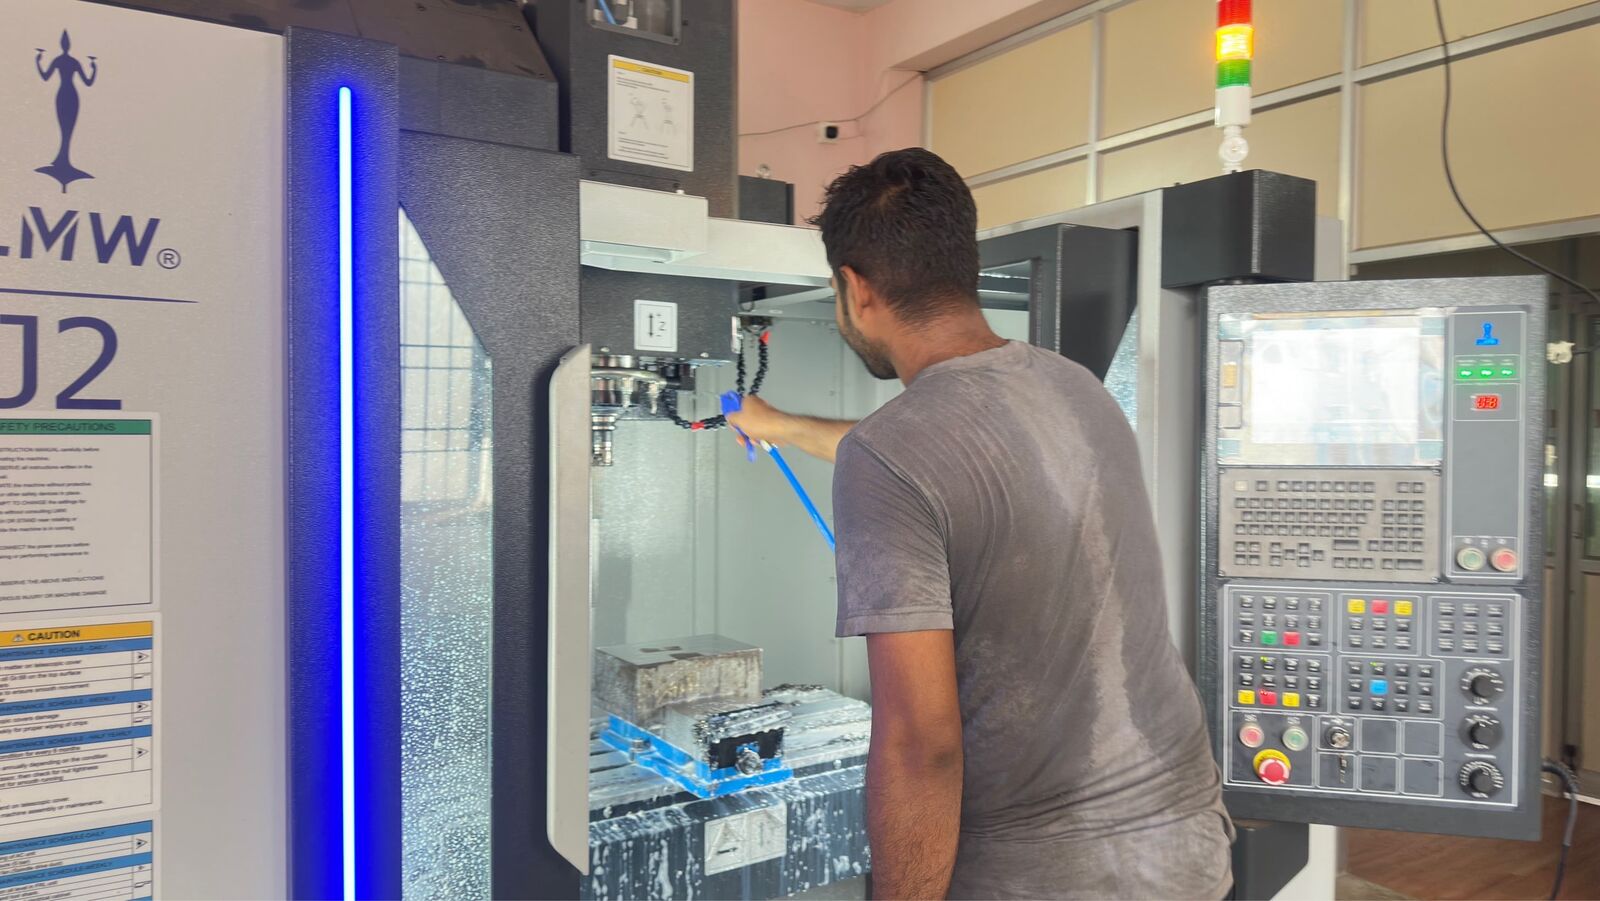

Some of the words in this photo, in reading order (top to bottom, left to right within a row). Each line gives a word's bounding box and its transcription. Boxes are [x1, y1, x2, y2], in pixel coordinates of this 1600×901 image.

[0, 206, 160, 266] MW
[33, 422, 117, 432] PRECAUTIONS
[28, 630, 81, 641] CAUTION
